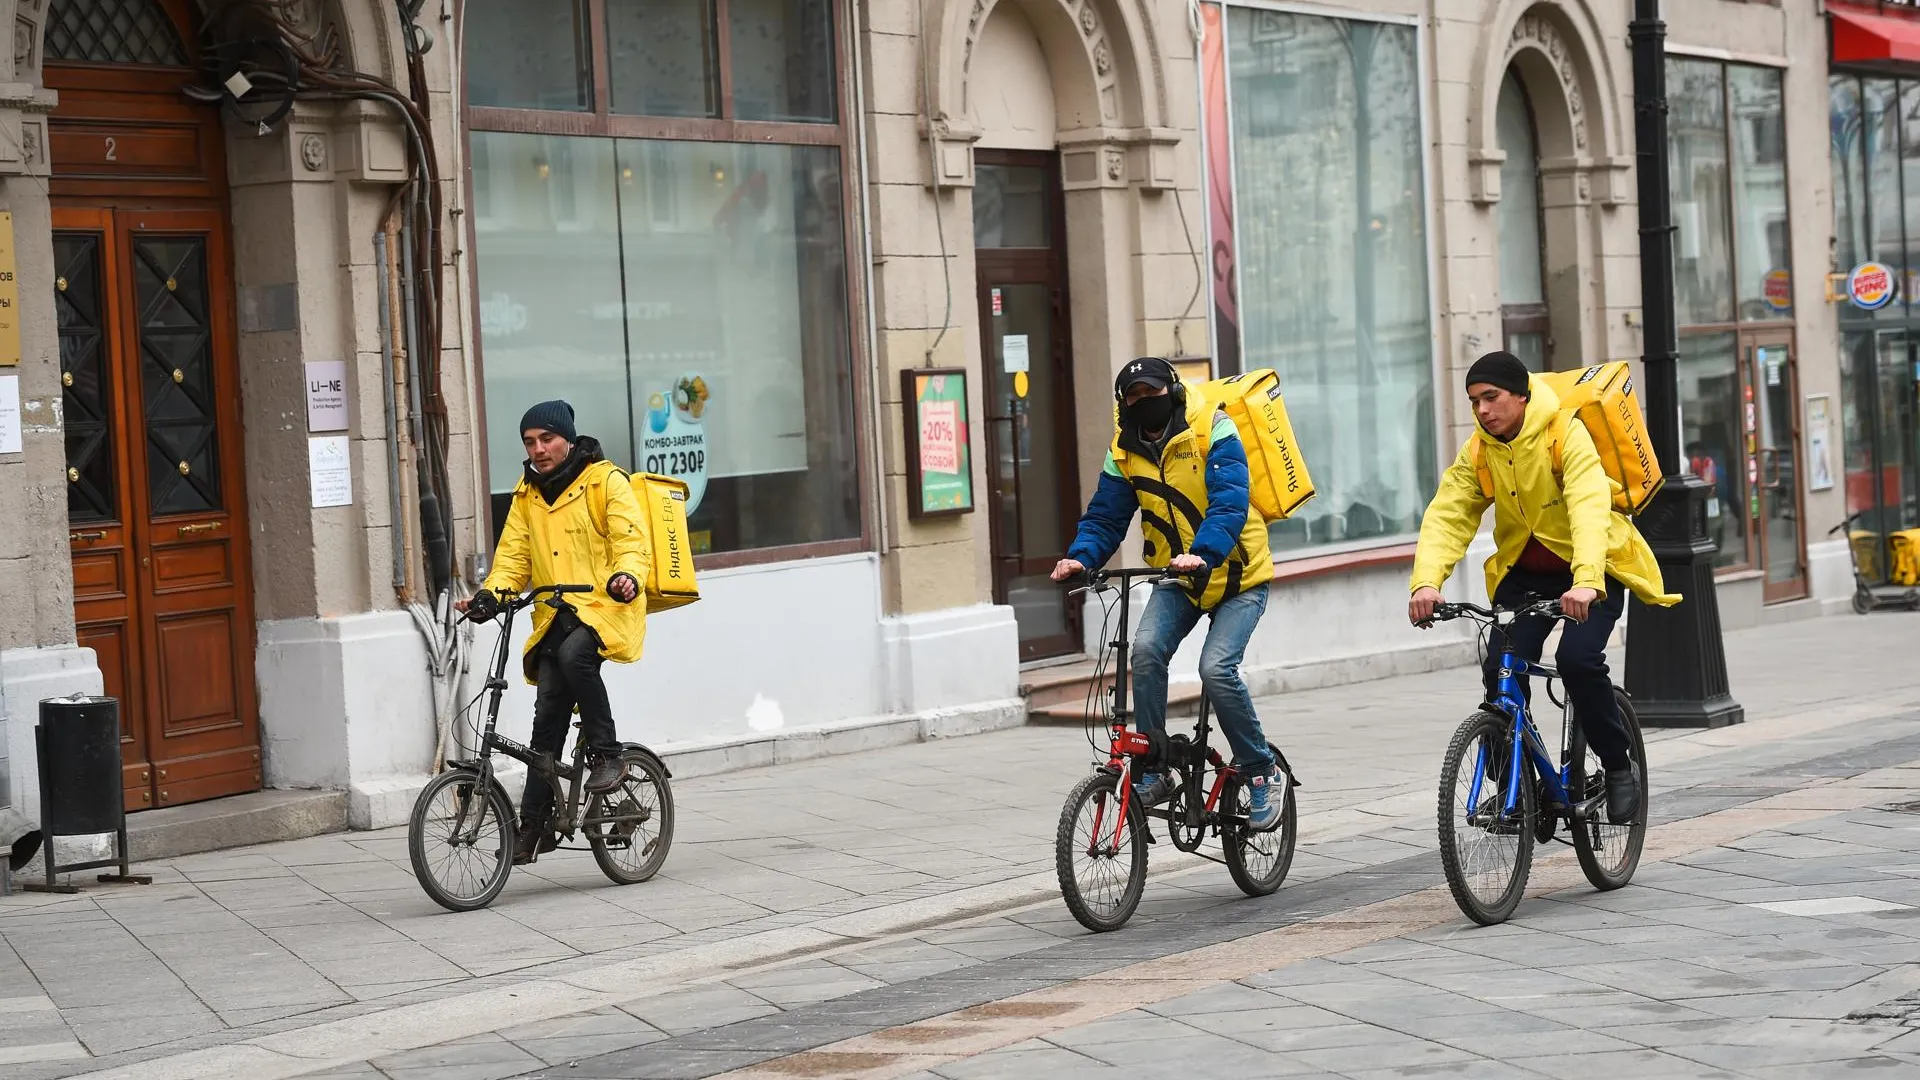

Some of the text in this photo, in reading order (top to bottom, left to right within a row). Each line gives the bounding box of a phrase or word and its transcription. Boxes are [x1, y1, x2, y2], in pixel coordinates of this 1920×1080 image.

[105, 137, 117, 161] 2
[1854, 281, 1888, 296] KING
[1263, 402, 1279, 434] Еда
[1618, 400, 1634, 434] Еда
[645, 434, 703, 449] КОМБО-ЗАВТРАК
[923, 421, 953, 442] -20%
[647, 453, 667, 475] ОТ
[1275, 434, 1299, 493] Яндекс
[662, 497, 681, 579] Яндекс Еда
[497, 736, 522, 751] STERN
